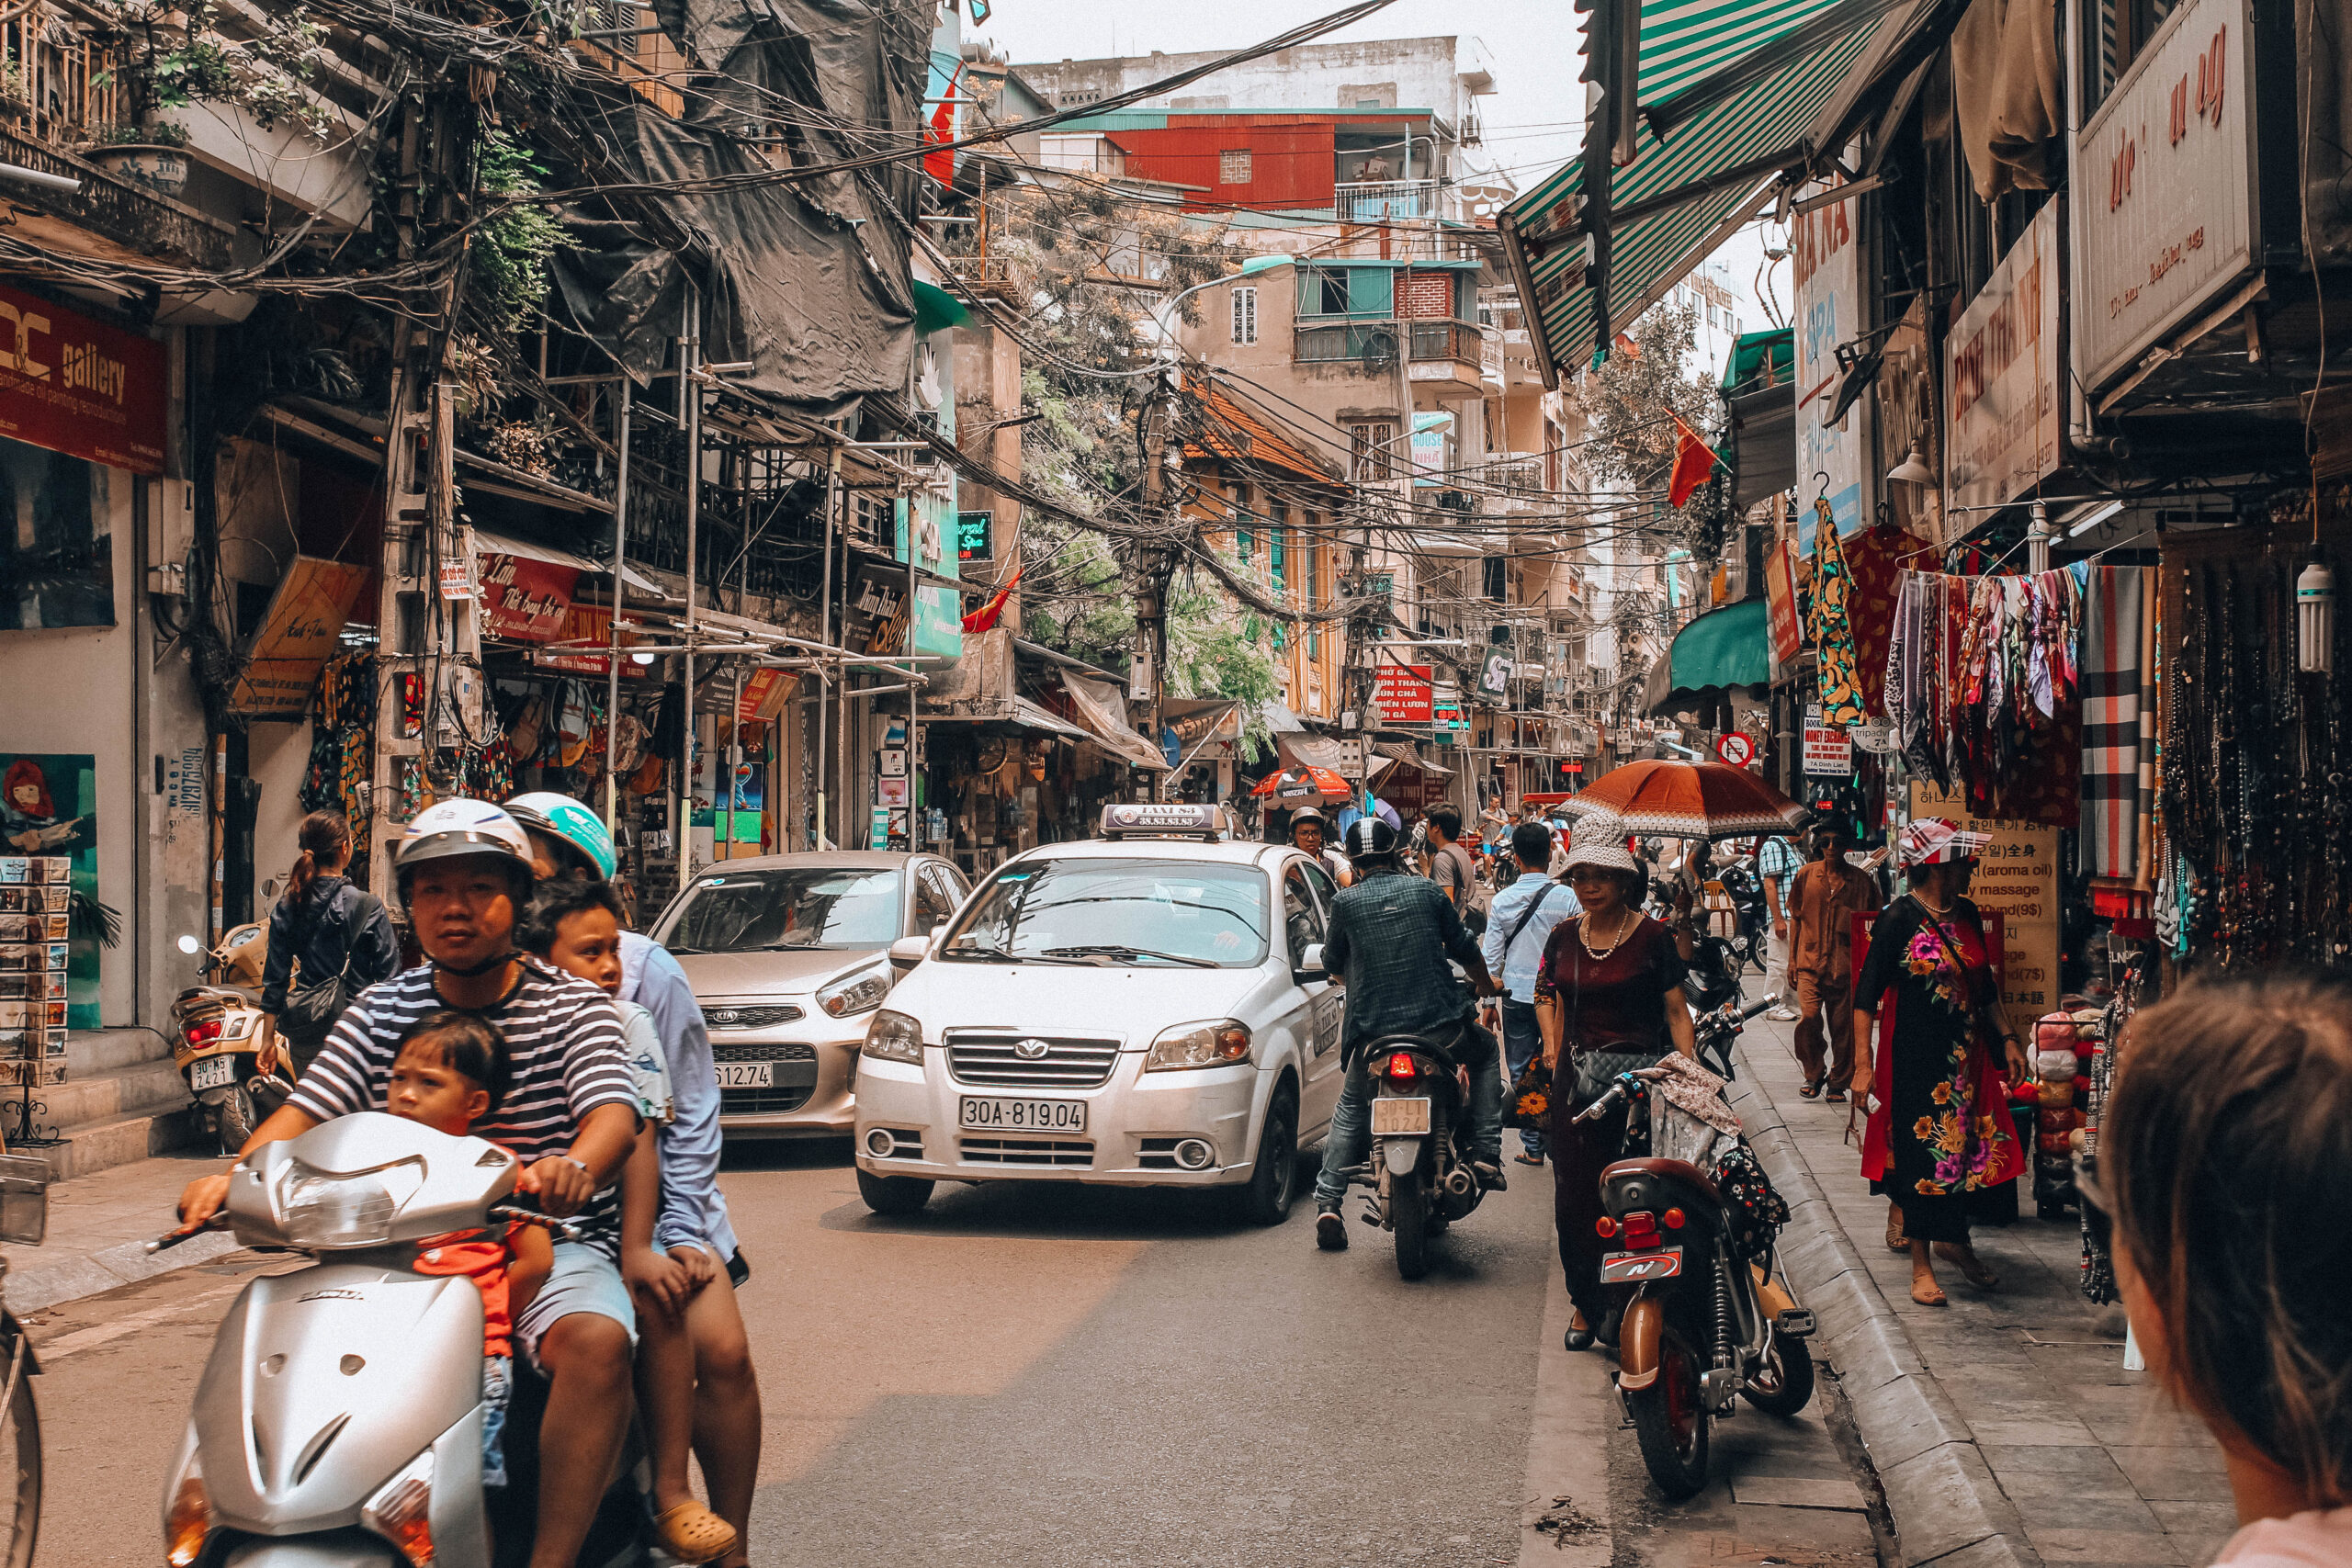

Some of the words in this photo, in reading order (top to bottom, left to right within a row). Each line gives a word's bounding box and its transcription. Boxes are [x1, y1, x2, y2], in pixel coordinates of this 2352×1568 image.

[1808, 291, 1836, 366] SPA
[62, 342, 126, 404] gallery
[0, 371, 35, 397] andmade
[1413, 434, 1442, 447] HOUSE
[956, 518, 986, 536] ural
[961, 535, 983, 551] Spa
[580, 612, 592, 640] IN
[1438, 710, 1467, 720] SPA
[1805, 729, 1823, 743] MONEY
[1856, 728, 1890, 739] tripadvi
[1874, 739, 1886, 747] 7A
[1138, 817, 1193, 827] 38.83.83.83
[1983, 864, 2029, 879] (aroma
[2032, 864, 2052, 879] oil)
[1980, 886, 2040, 897] massage
[716, 1011, 734, 1021] KIA
[197, 1070, 226, 1089] 2421
[715, 1066, 768, 1085] 612.74
[965, 1100, 1081, 1128] 30A-819.04
[1381, 1116, 1421, 1133] 1024
